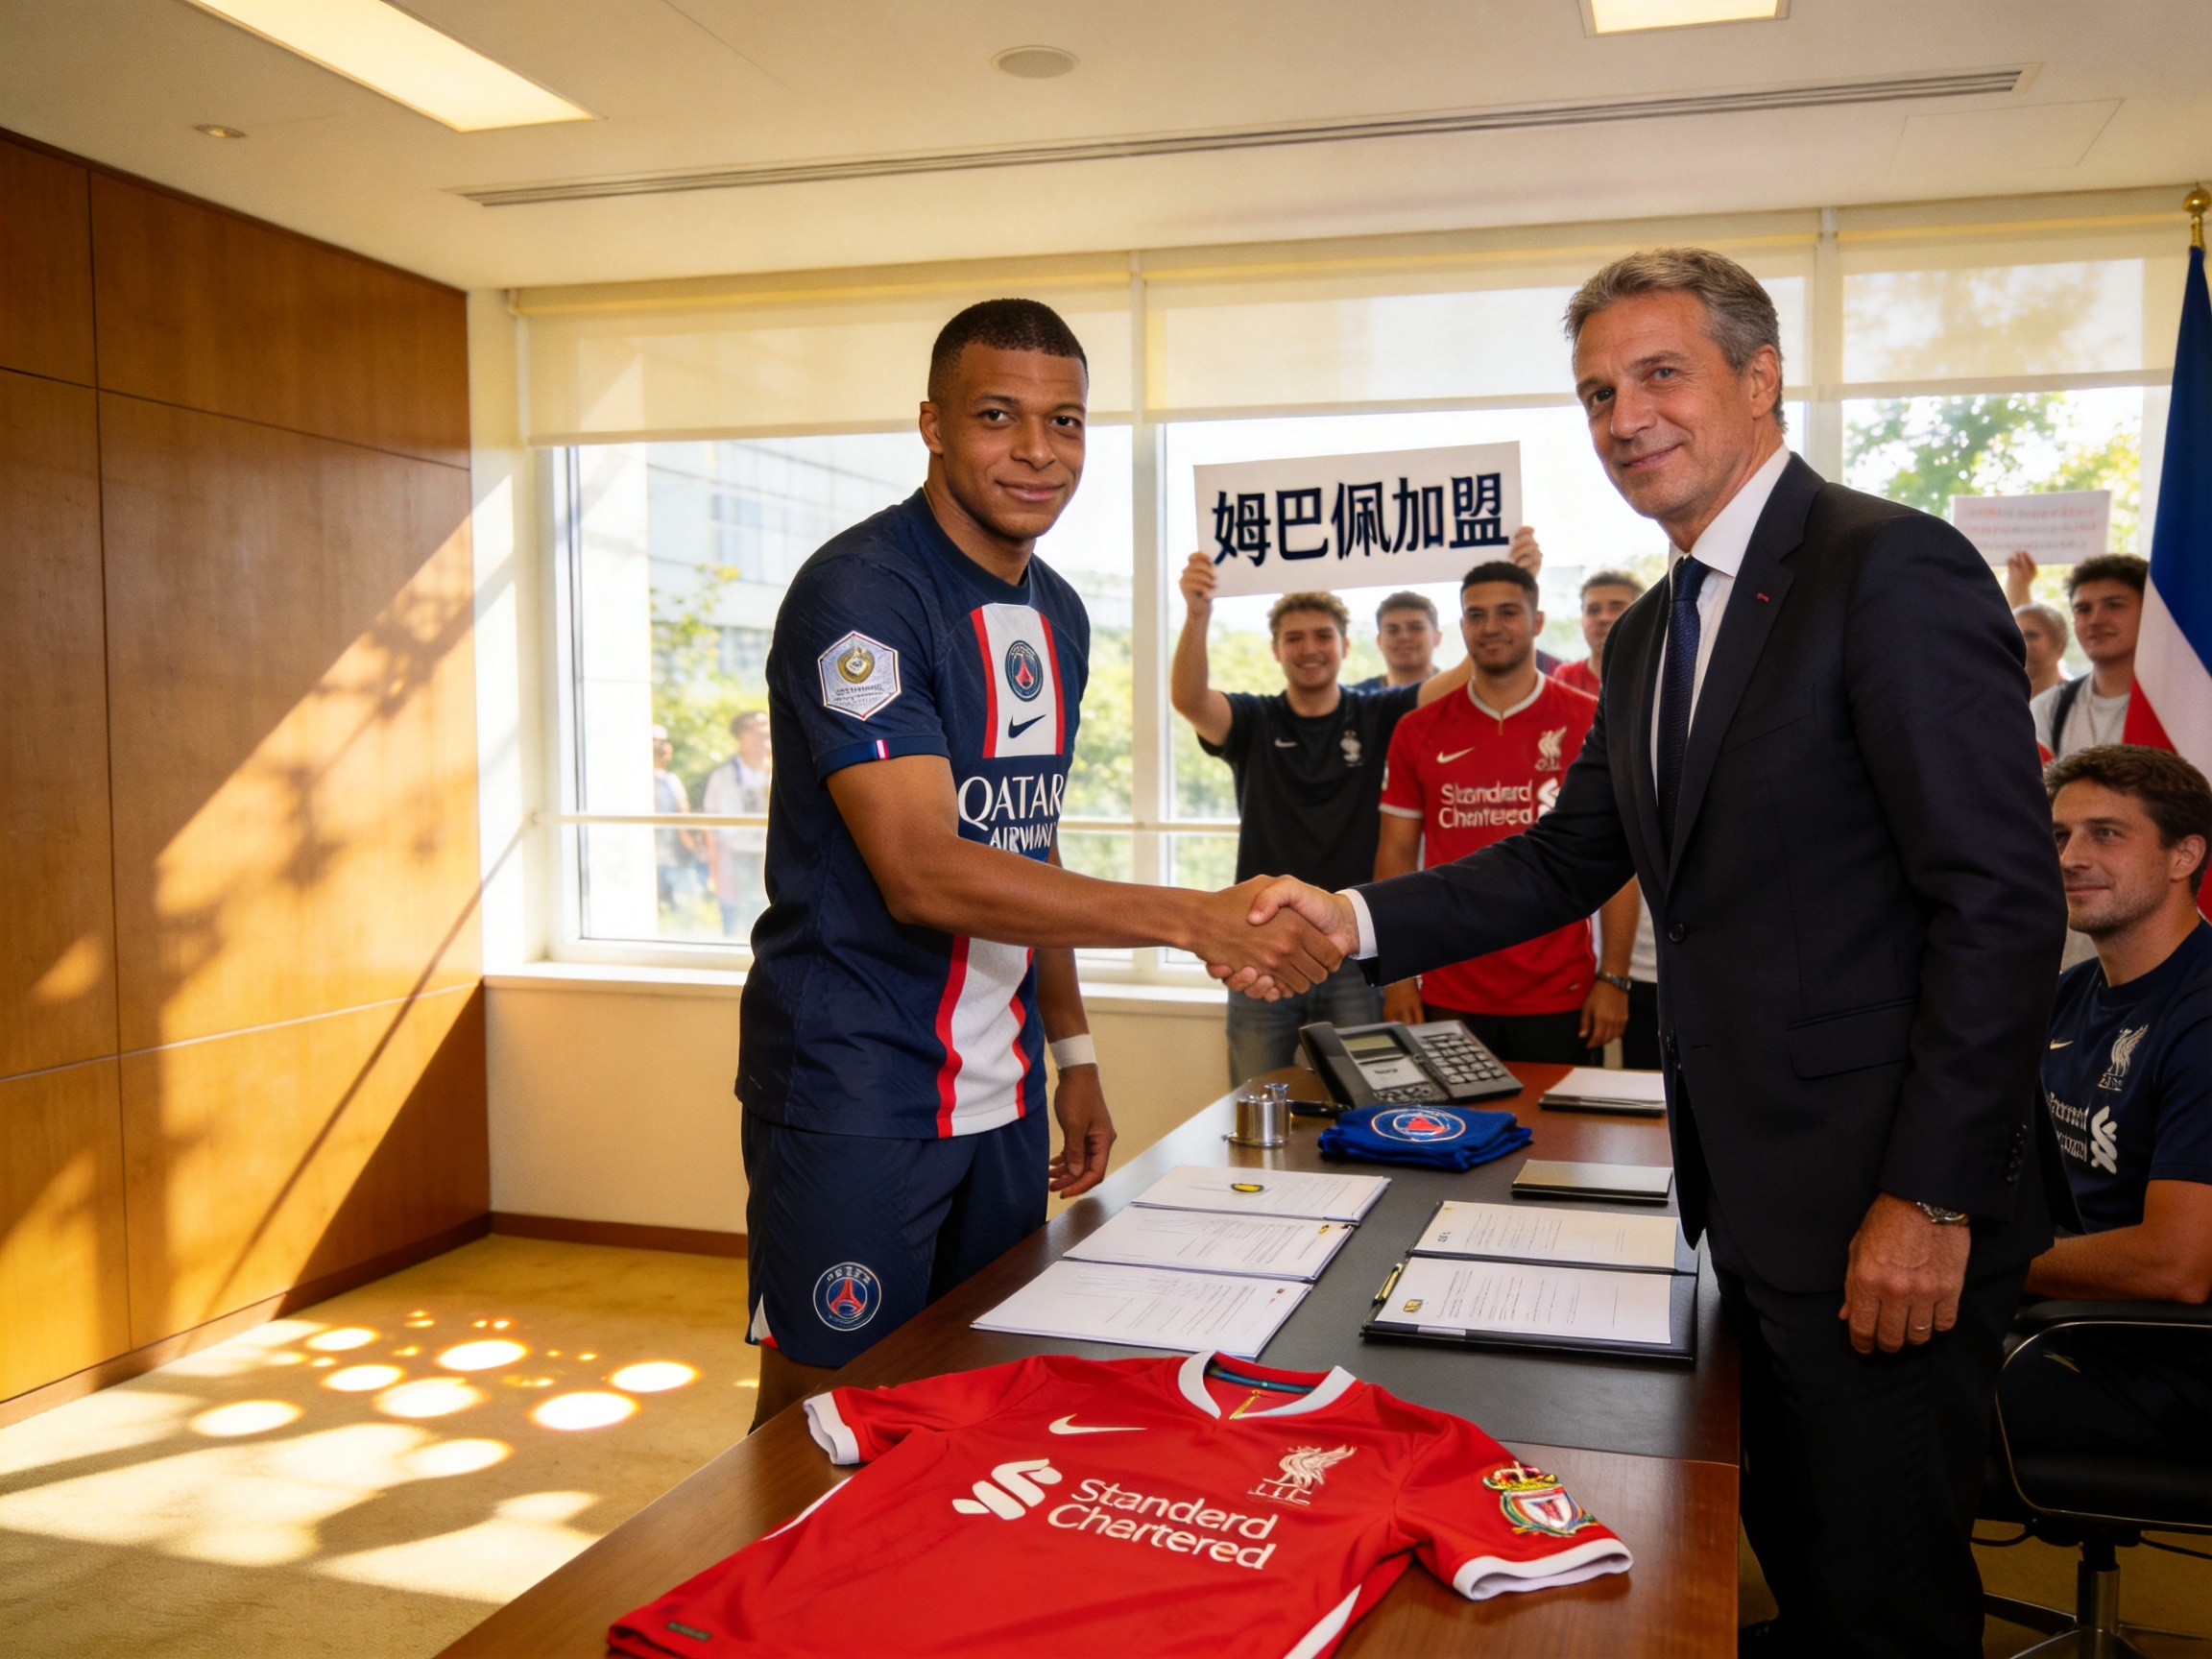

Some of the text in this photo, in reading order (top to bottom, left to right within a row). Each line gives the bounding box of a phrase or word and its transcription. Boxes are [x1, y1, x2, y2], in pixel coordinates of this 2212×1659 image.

[1212, 472, 1509, 567] 姆巴佩加盟
[958, 773, 1064, 831] QATAR
